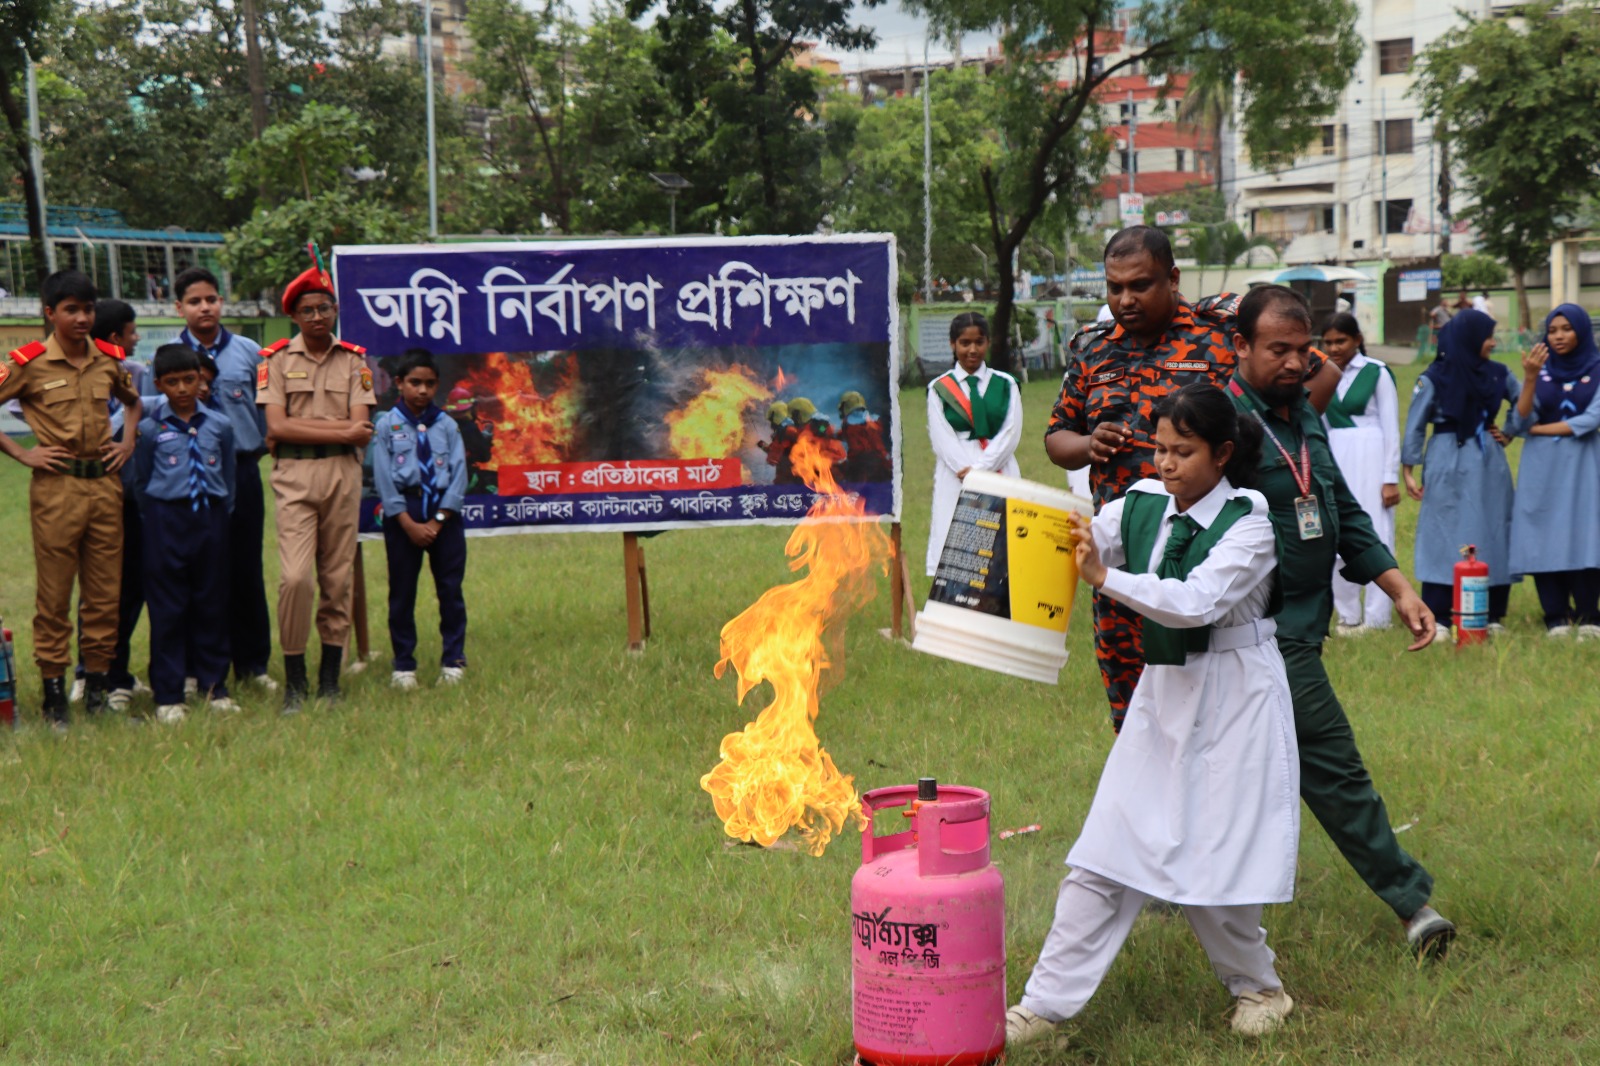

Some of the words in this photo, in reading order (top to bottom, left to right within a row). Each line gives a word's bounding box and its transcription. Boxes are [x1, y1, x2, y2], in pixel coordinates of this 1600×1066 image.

[356, 267, 468, 345] অগ্নি
[477, 263, 663, 336] নির্বাপণ
[677, 261, 862, 331] প্রশিক্ষণ
[1179, 362, 1207, 370] BANGLADESH
[524, 470, 561, 492] স্থান
[581, 461, 679, 486] প্রতিষ্ঠানের
[685, 459, 722, 482] মাঠ
[505, 496, 573, 519] হালিশহর
[580, 495, 664, 517] ক্যান্টনমেন্ট
[670, 490, 733, 514] পাবলিক
